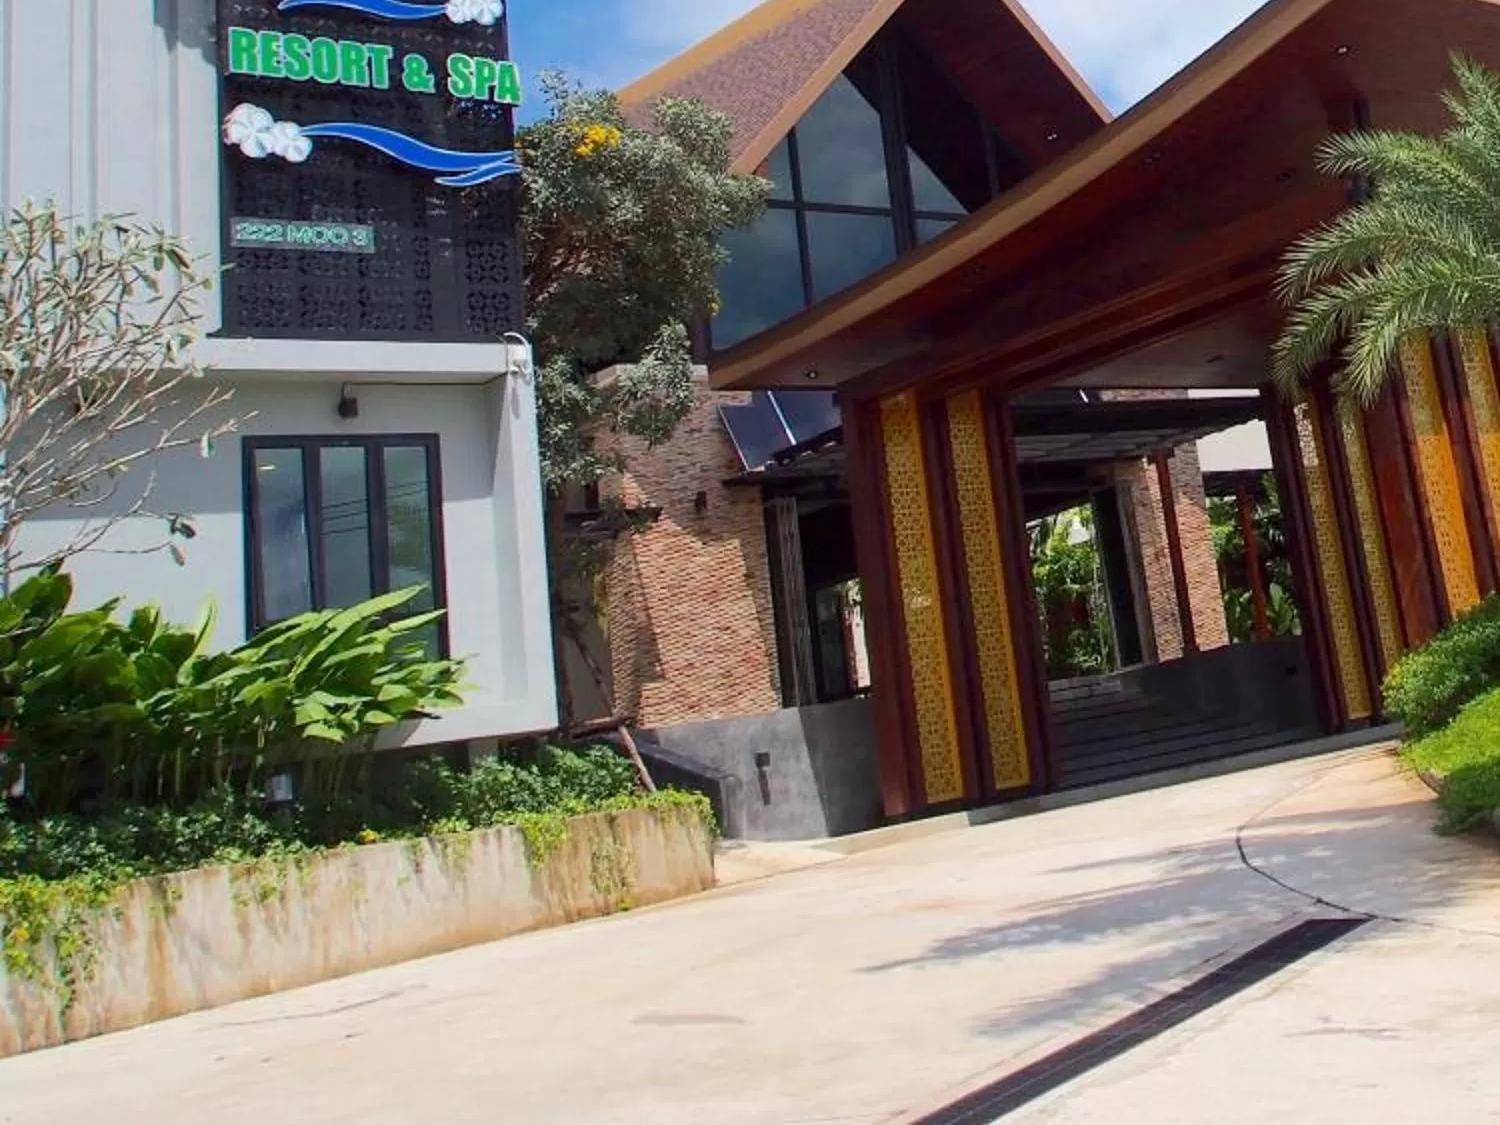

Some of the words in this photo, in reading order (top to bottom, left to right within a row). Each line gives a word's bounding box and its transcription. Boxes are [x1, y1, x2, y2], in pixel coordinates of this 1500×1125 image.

[228, 27, 393, 89] RESORT
[402, 53, 435, 93] &
[447, 53, 522, 106] SPA
